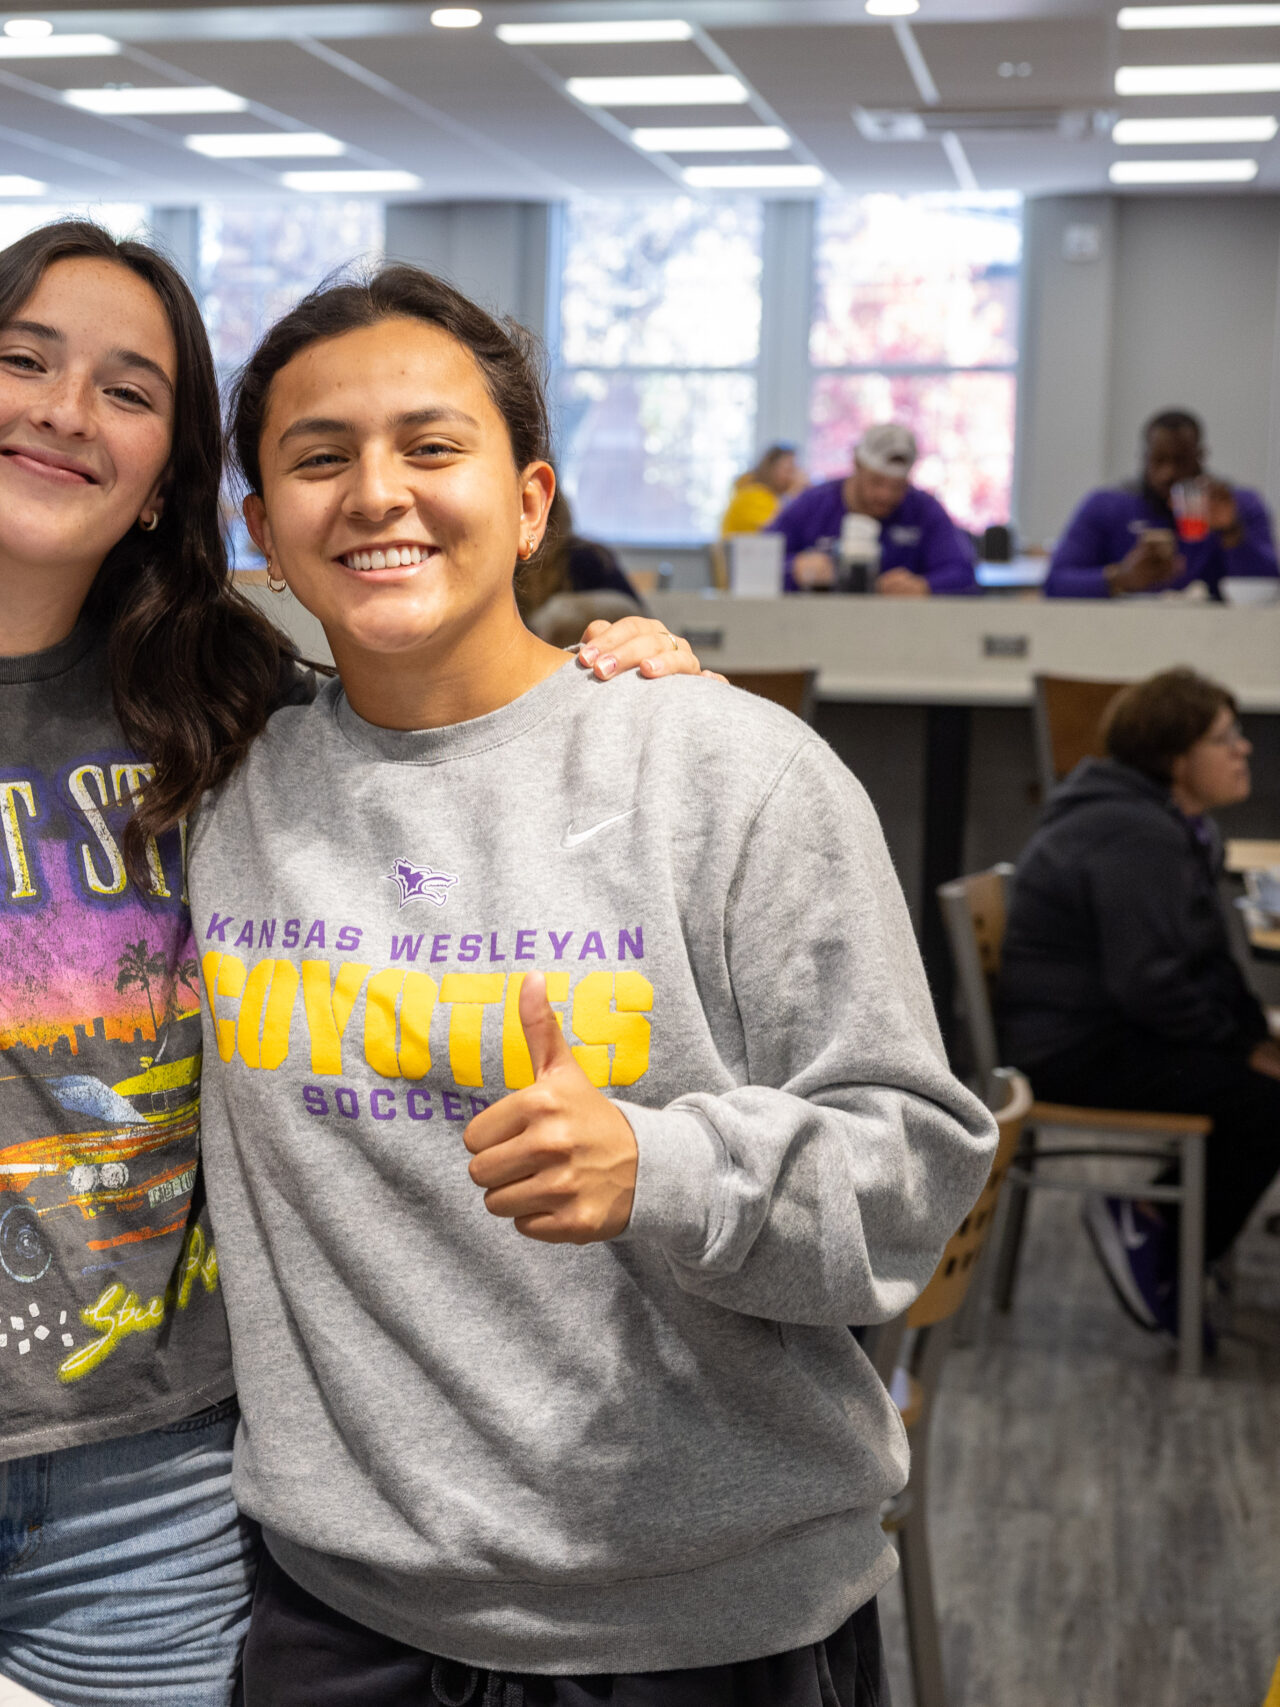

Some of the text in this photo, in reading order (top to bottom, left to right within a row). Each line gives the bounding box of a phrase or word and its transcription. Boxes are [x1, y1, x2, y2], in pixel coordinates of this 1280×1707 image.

[68, 763, 191, 905] ST
[205, 912, 645, 963] KANSAS WESLEYAN
